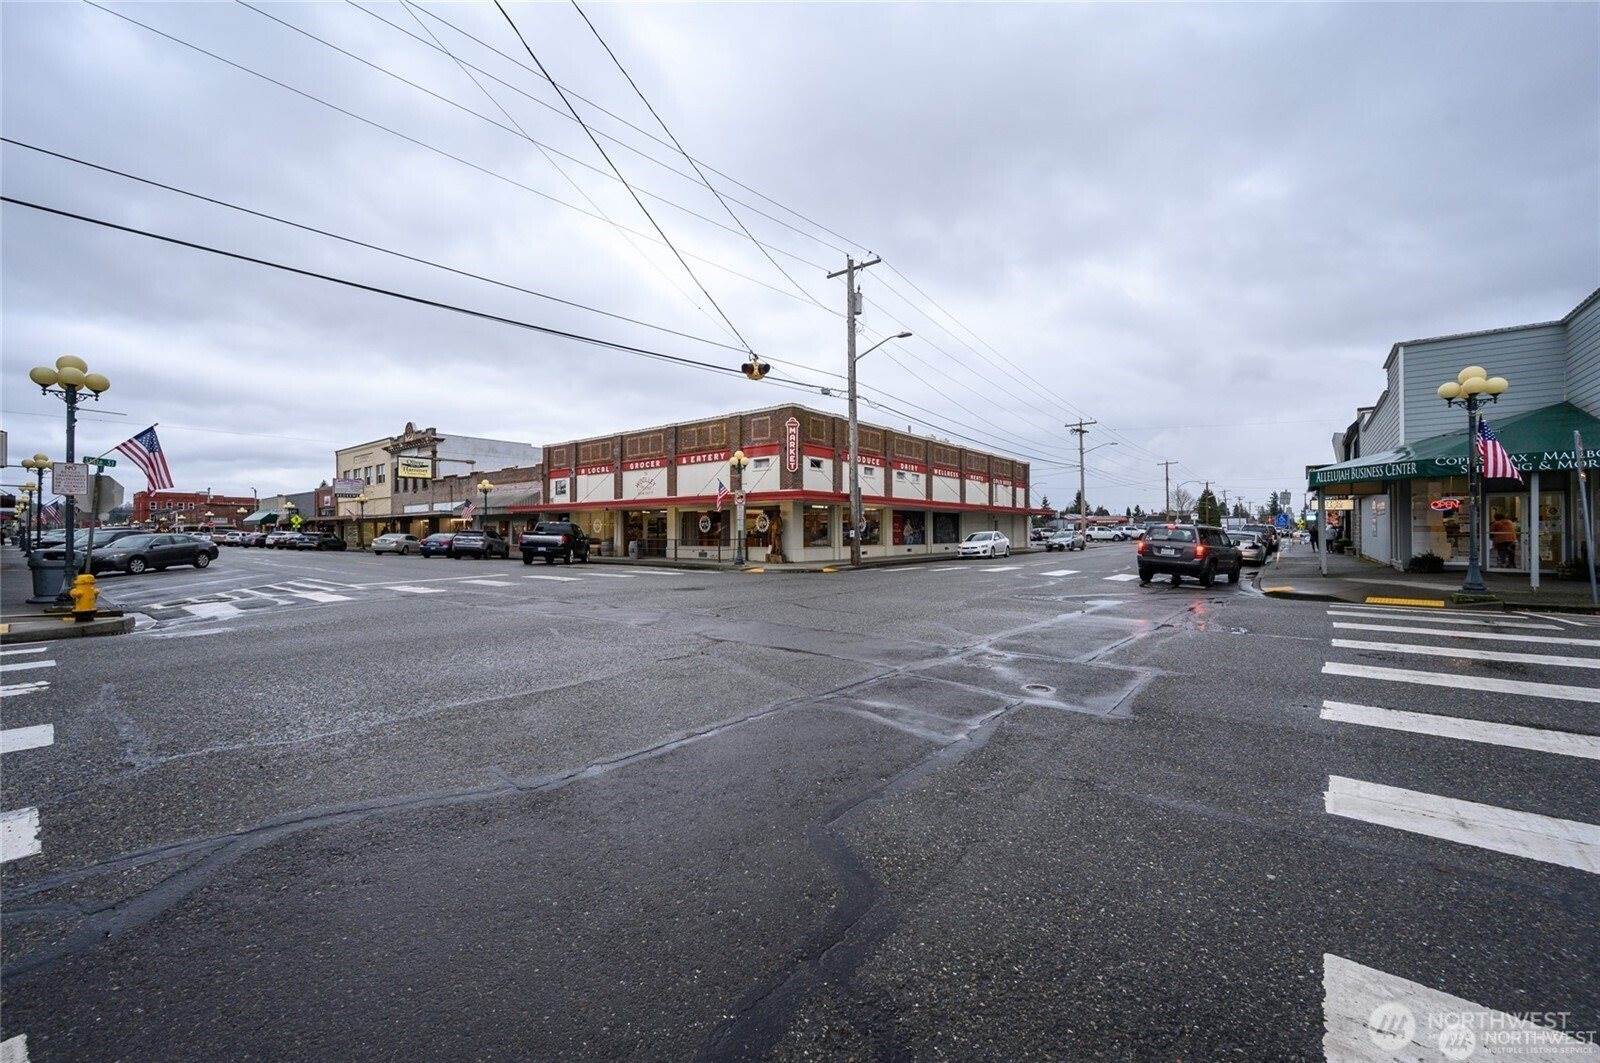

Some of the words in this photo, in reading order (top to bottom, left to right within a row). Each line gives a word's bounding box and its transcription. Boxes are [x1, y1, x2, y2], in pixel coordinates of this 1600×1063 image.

[588, 466, 610, 475] LOCAL
[629, 460, 661, 470] GROCER
[690, 452, 726, 463] EATERY
[900, 463, 919, 472] DAIRY
[934, 468, 959, 478] WELLNESS
[1316, 468, 1350, 482] ALLELUJAH
[1351, 465, 1384, 480] BUSINESS
[1385, 461, 1418, 477] CENTER
[1433, 500, 1459, 509] OPEN
